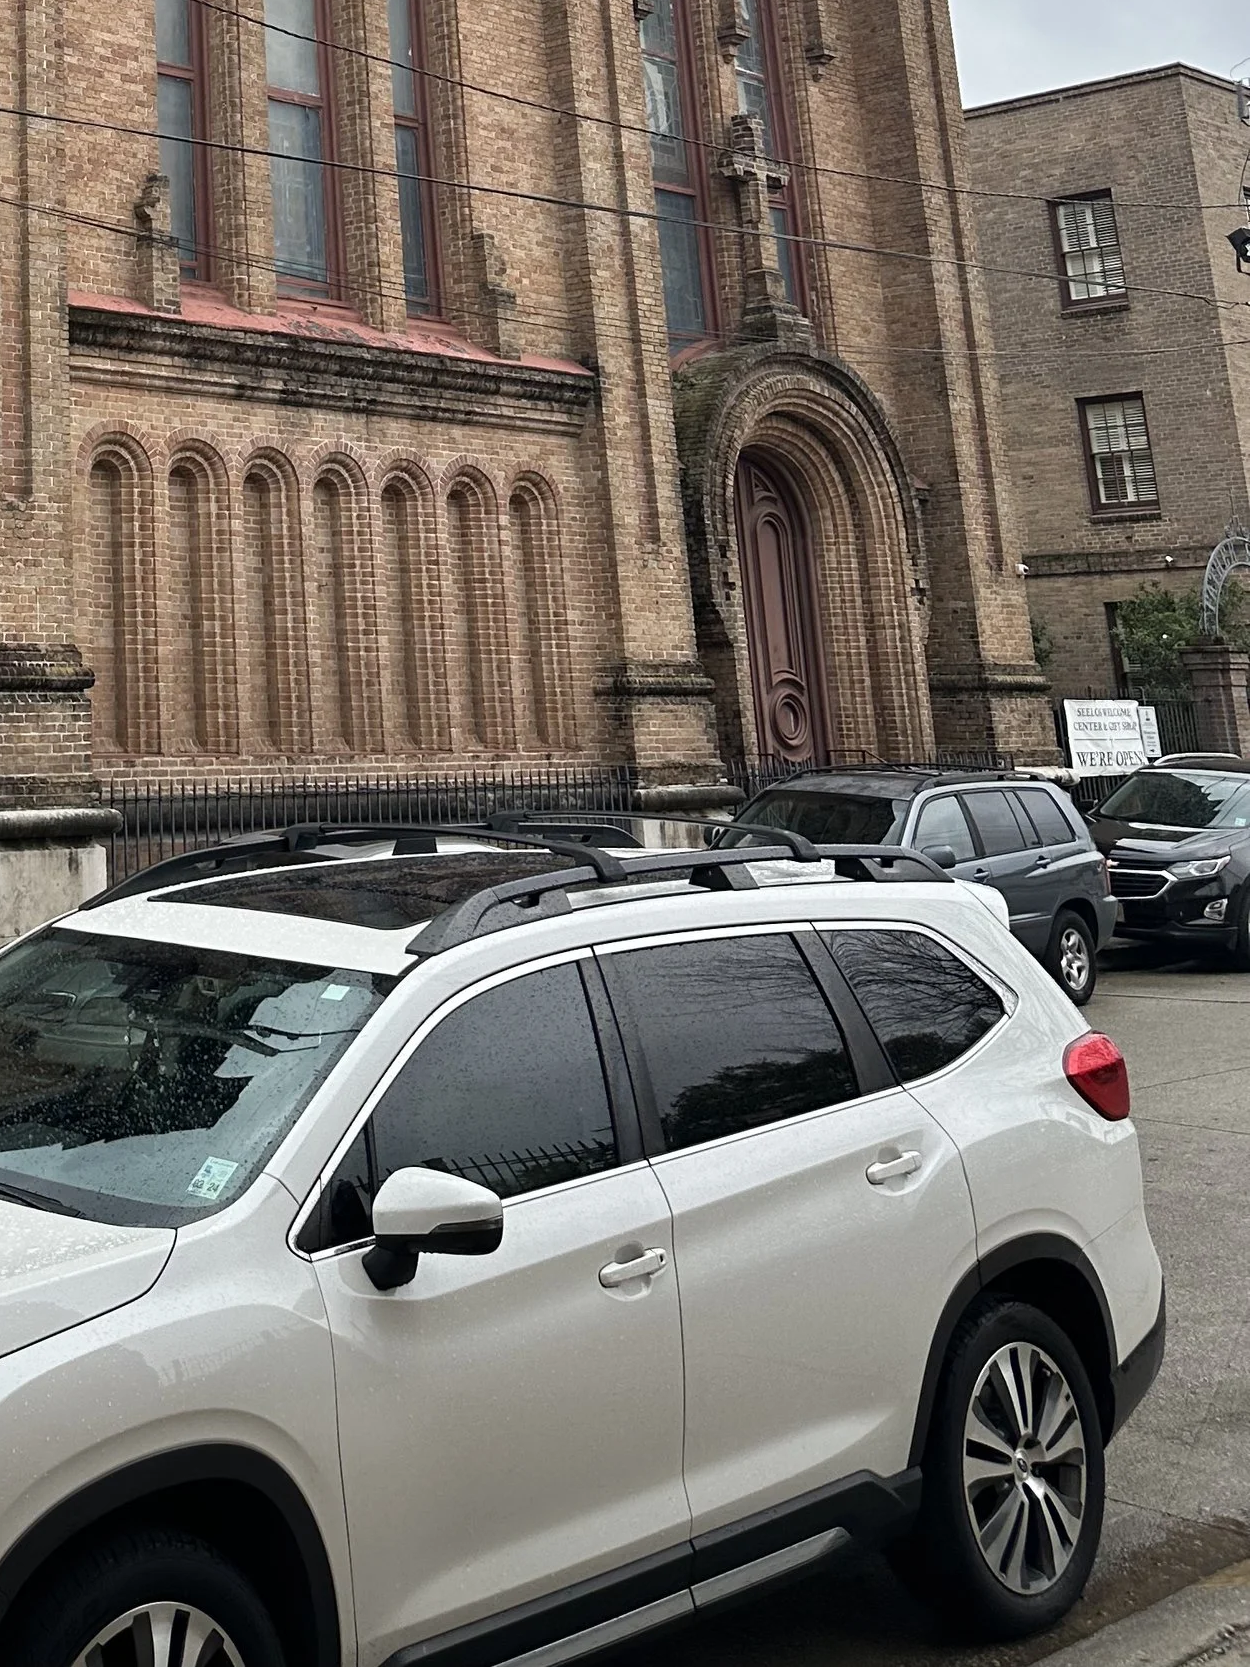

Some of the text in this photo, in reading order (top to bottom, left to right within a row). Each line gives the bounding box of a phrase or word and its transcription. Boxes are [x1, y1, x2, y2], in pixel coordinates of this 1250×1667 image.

[1102, 707, 1131, 717] WELCOME
[1073, 721, 1103, 731] CENTER
[1109, 721, 1121, 731] GIFT
[1076, 751, 1113, 767] WE'RE
